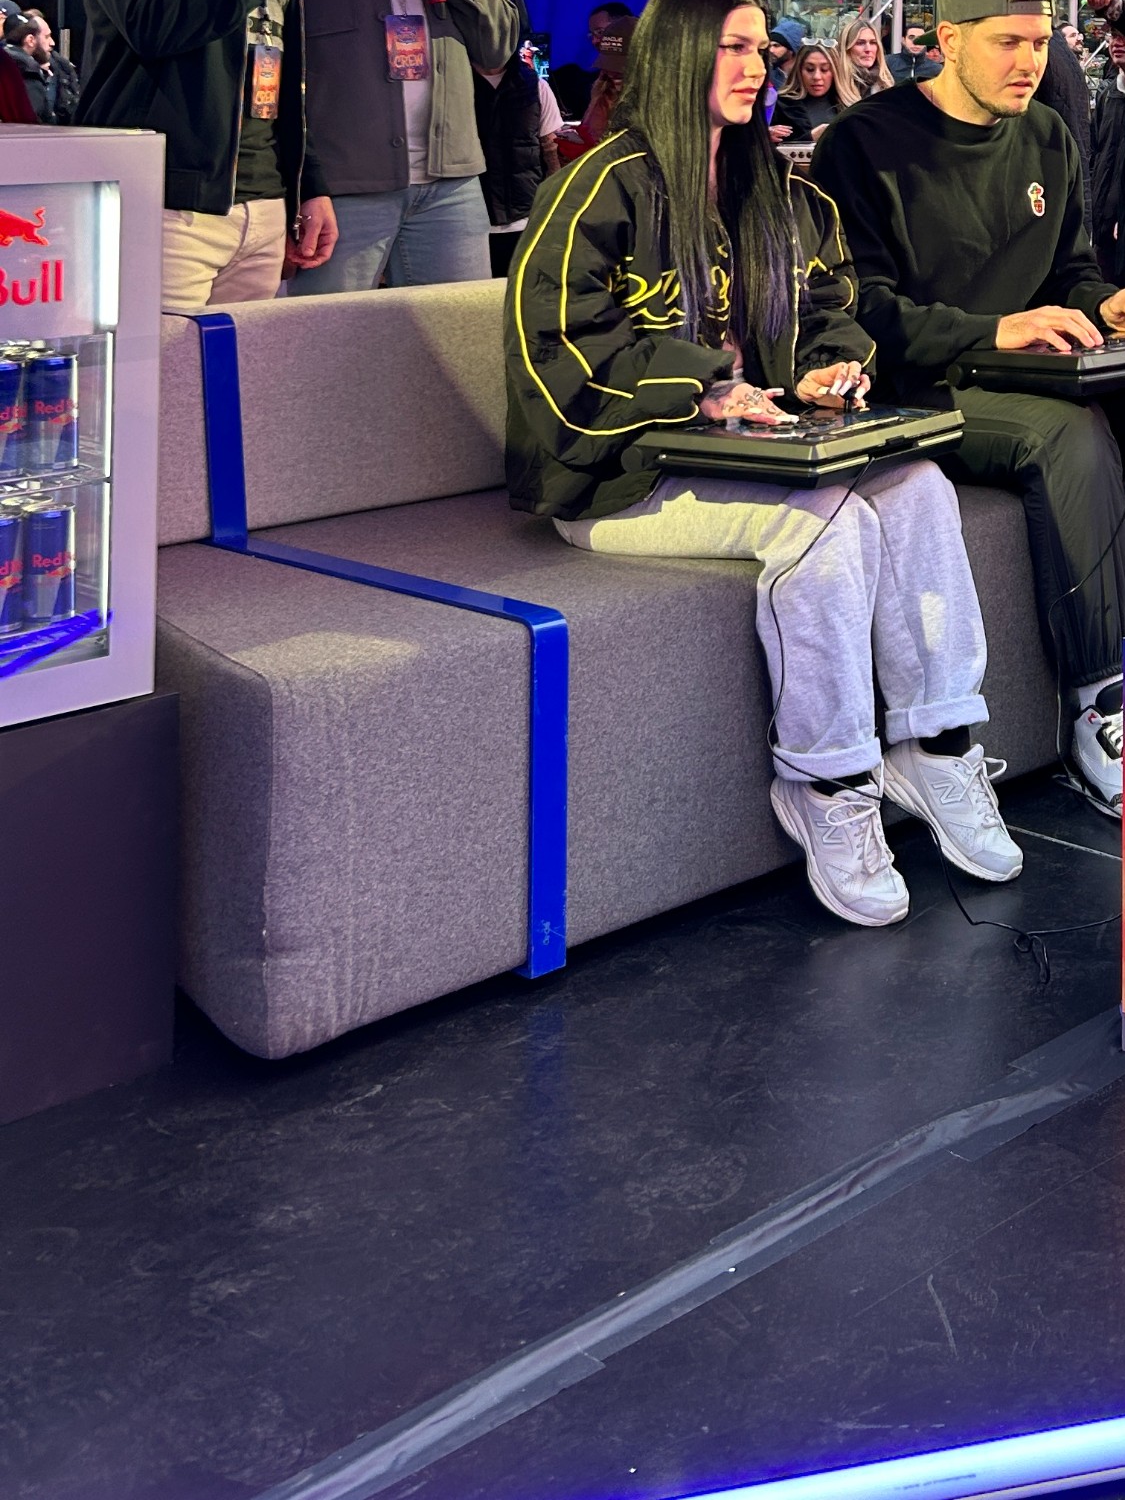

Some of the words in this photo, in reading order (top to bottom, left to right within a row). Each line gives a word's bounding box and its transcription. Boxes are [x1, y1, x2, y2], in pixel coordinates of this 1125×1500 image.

[394, 53, 423, 68] CREW
[34, 399, 65, 414] Red
[32, 551, 63, 568] Red
